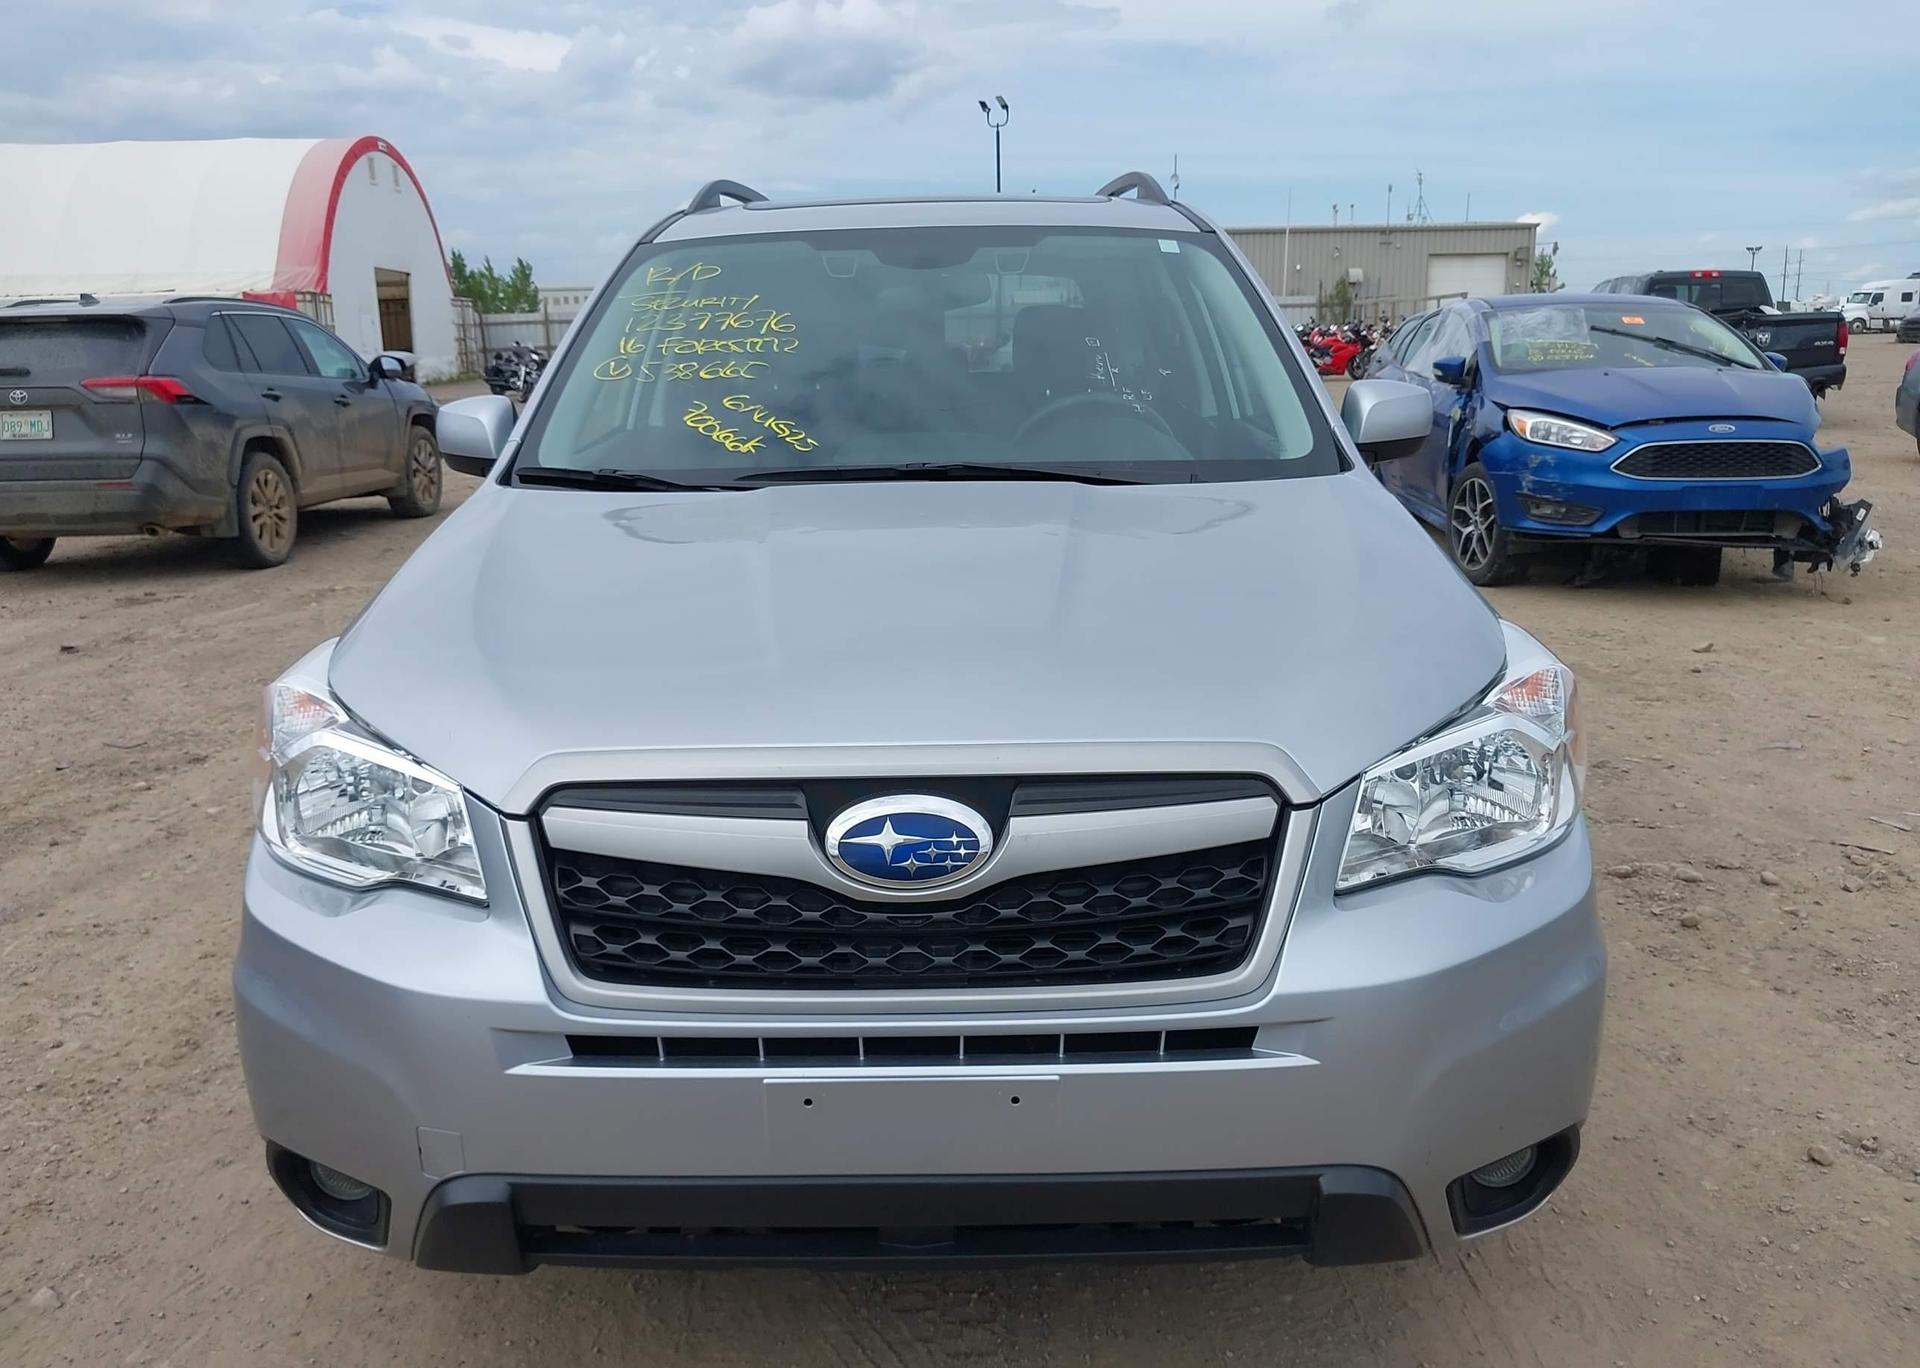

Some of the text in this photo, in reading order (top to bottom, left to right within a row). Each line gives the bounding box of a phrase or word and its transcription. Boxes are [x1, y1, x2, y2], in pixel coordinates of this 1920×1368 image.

[618, 336, 646, 355] 16
[3, 420, 50, 433] 089 MDJ
